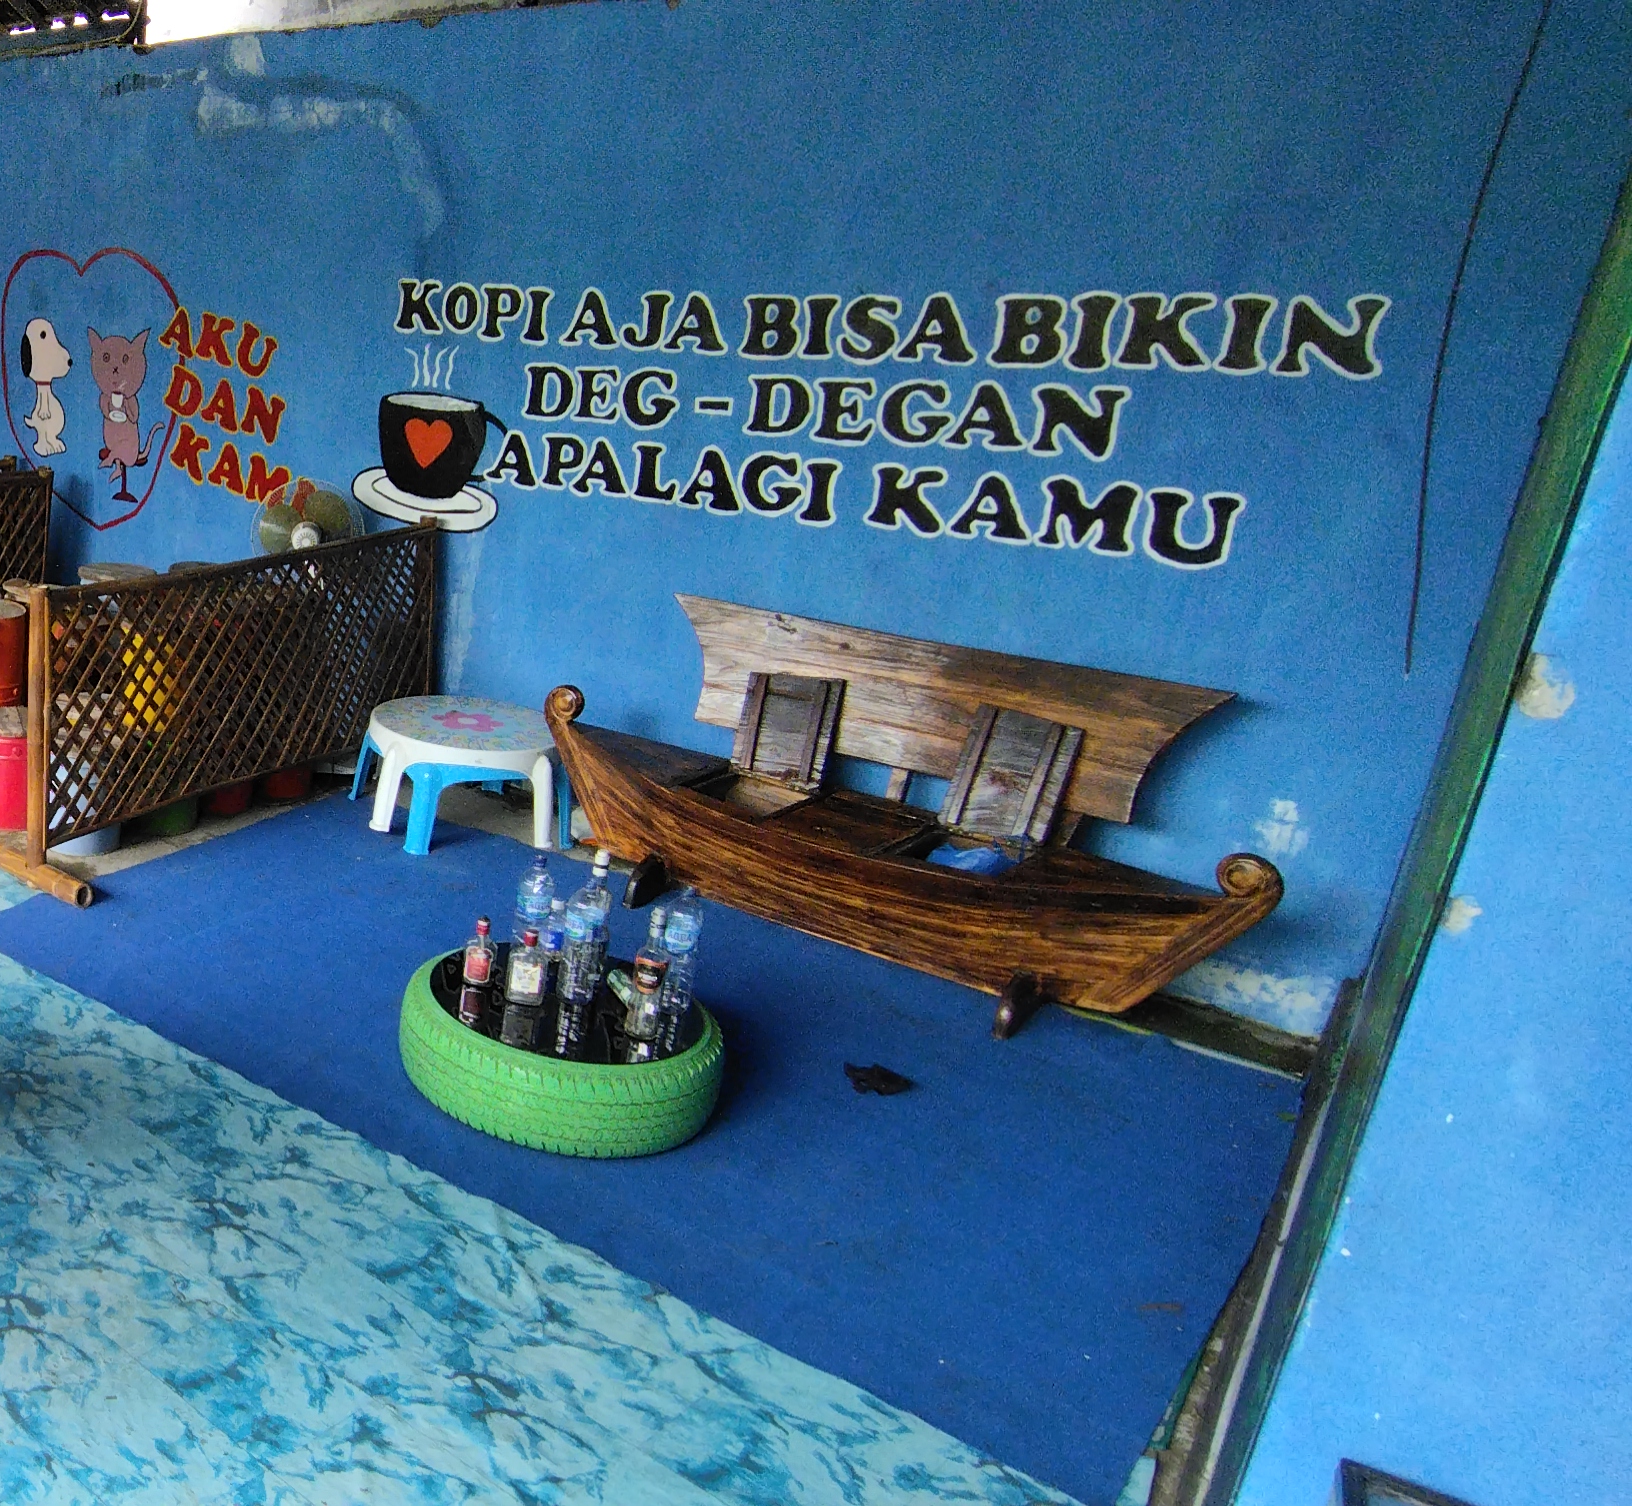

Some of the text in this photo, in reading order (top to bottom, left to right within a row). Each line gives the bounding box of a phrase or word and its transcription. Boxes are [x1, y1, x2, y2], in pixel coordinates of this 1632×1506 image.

[158, 306, 279, 378] AKU
[394, 279, 1391, 380] KOPI AJA BISA BIKIN
[164, 364, 287, 446] DAN
[522, 363, 677, 430] DEG
[743, 374, 1131, 461] DEGAN
[484, 430, 1246, 570] APALAGI KAMU
